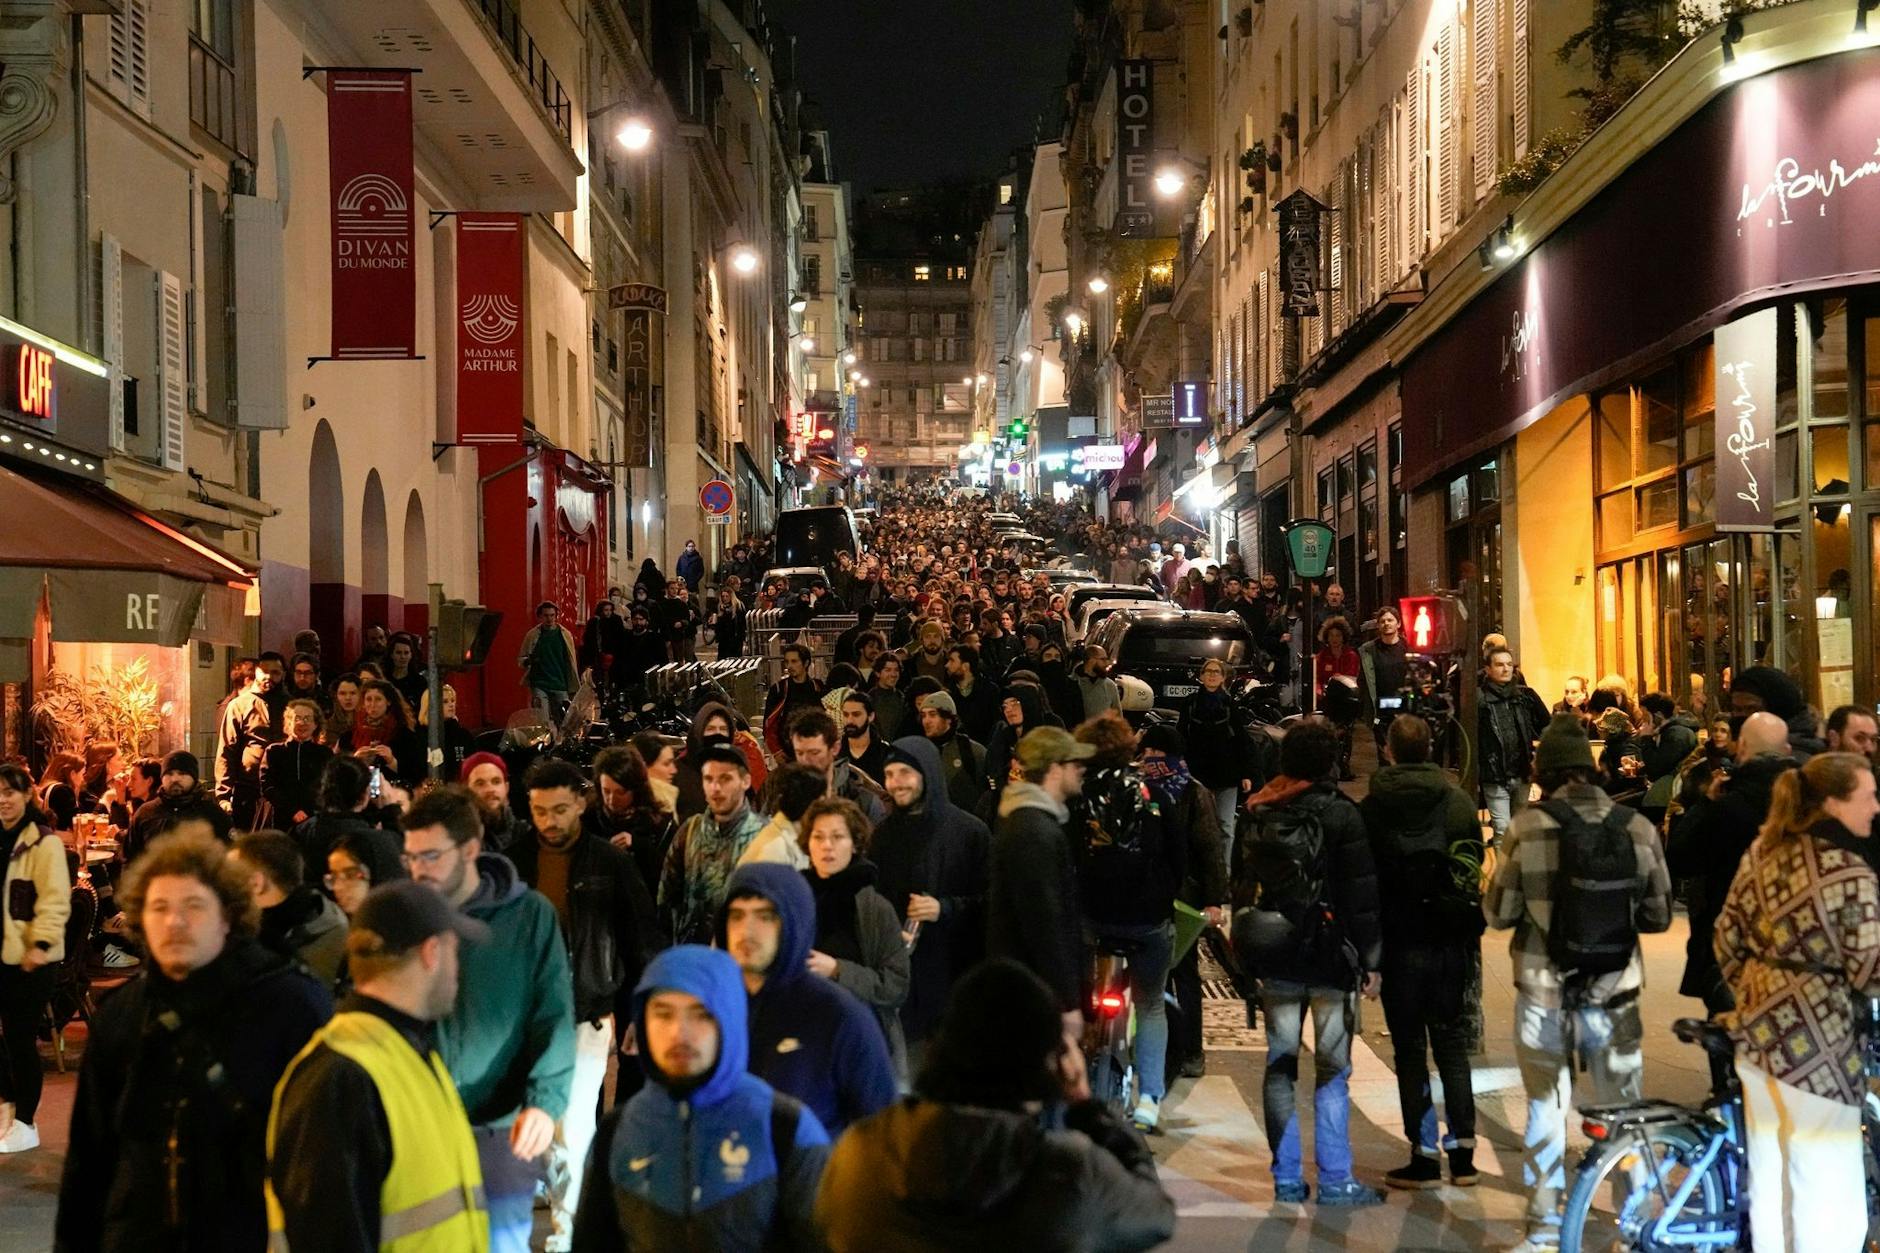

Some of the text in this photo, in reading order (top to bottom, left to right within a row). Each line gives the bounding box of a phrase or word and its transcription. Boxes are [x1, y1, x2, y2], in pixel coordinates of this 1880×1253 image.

[1123, 65, 1149, 207] HOTEL
[338, 239, 409, 256] DIVAN
[338, 257, 409, 269] DU MONDE
[464, 349, 516, 358] MADAME
[463, 360, 518, 372] ARTHUR
[1737, 472, 1761, 512] la
